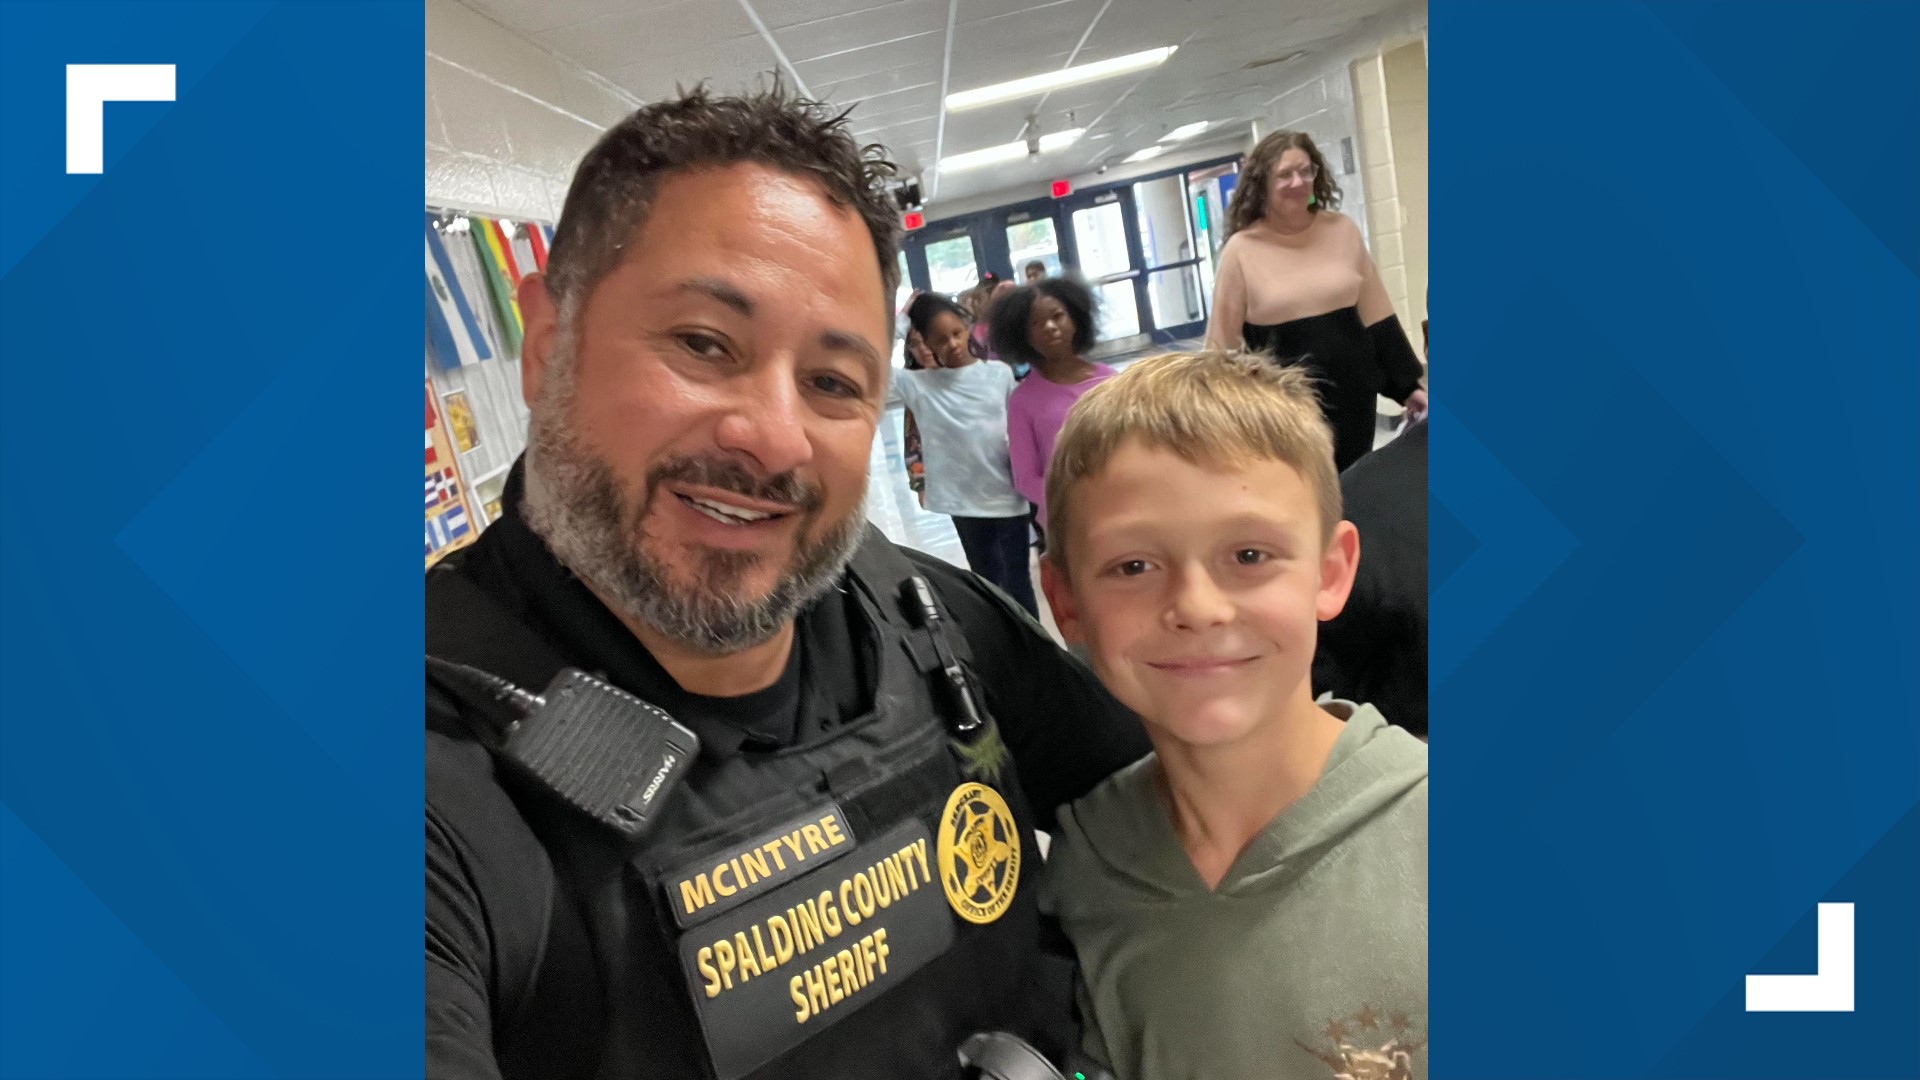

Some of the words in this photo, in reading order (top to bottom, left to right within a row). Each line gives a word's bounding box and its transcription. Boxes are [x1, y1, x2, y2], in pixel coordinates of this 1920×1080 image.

[643, 755, 676, 803] HARRIS
[679, 814, 846, 914] MCINTYRE
[697, 890, 842, 998] SPALDING
[839, 838, 932, 926] COUNTY
[789, 927, 890, 1024] SHERIFF
